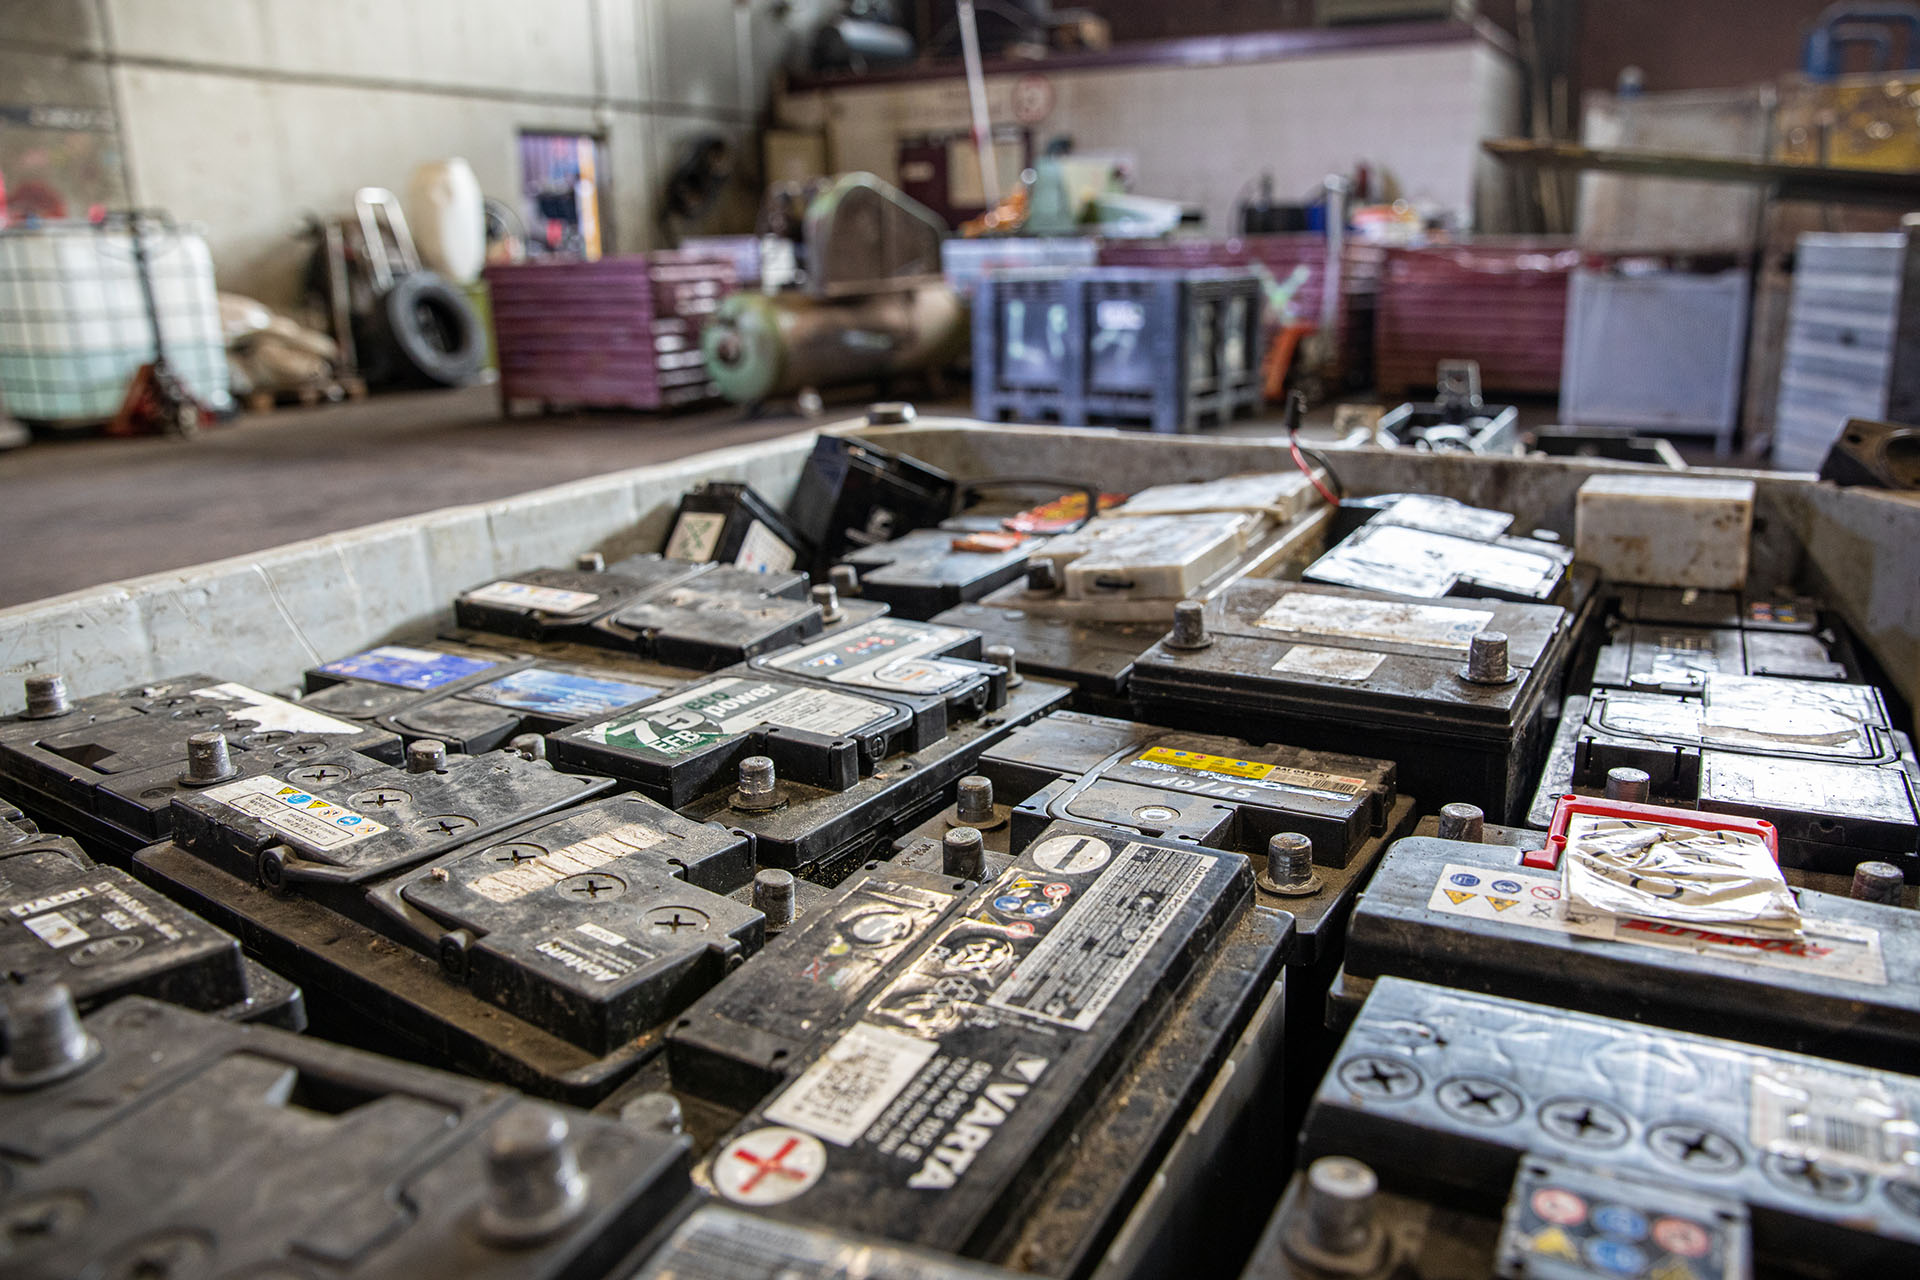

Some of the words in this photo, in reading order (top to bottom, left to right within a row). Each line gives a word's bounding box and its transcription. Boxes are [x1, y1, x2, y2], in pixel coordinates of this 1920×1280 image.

[686, 691, 730, 710] eco
[705, 684, 778, 718] power
[606, 708, 706, 748] 75
[649, 731, 702, 754] EFB
[537, 941, 621, 981] Achtung
[905, 1085, 1032, 1190] VARTA
